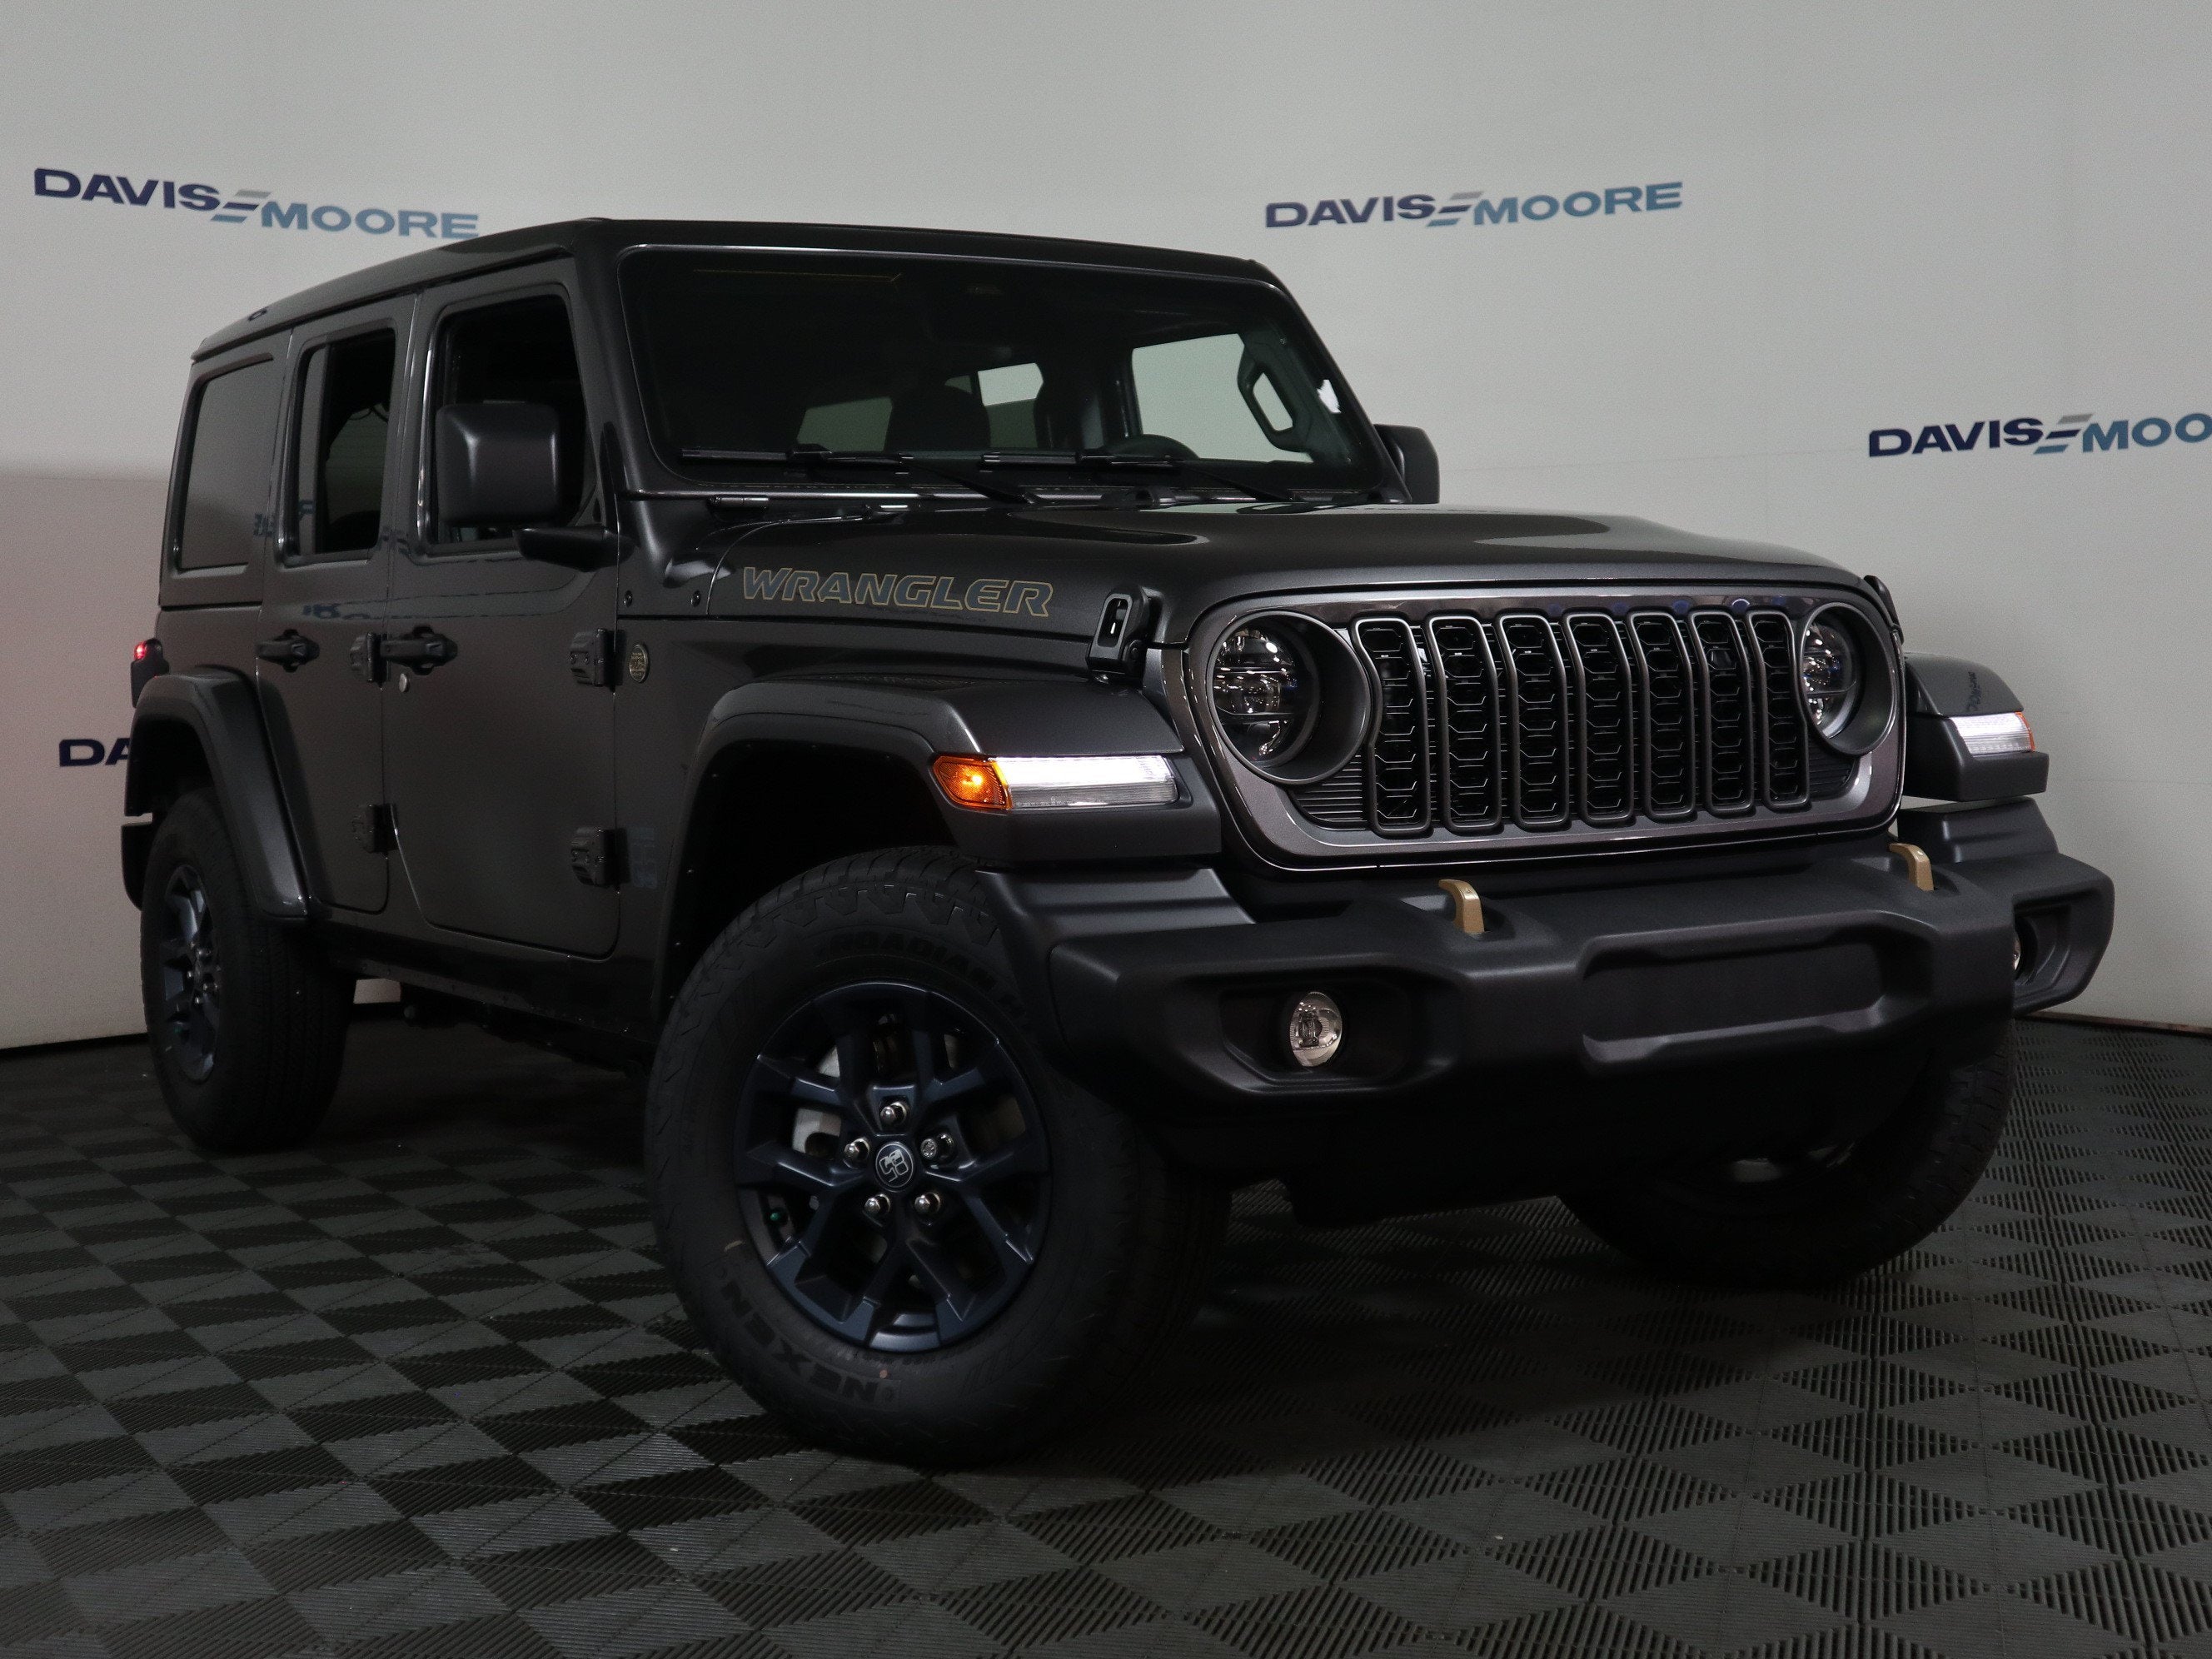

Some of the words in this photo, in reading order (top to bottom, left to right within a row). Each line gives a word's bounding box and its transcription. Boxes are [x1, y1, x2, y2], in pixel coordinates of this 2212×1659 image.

[34, 167, 221, 211] DAVIS
[260, 201, 480, 239] MOORE
[1265, 193, 1437, 228] DAVIS
[1472, 181, 1683, 226] MOORE
[1868, 417, 2044, 458] DAVIS
[743, 566, 1054, 618] WRANGLER
[720, 1280, 879, 1403] NEXEN
